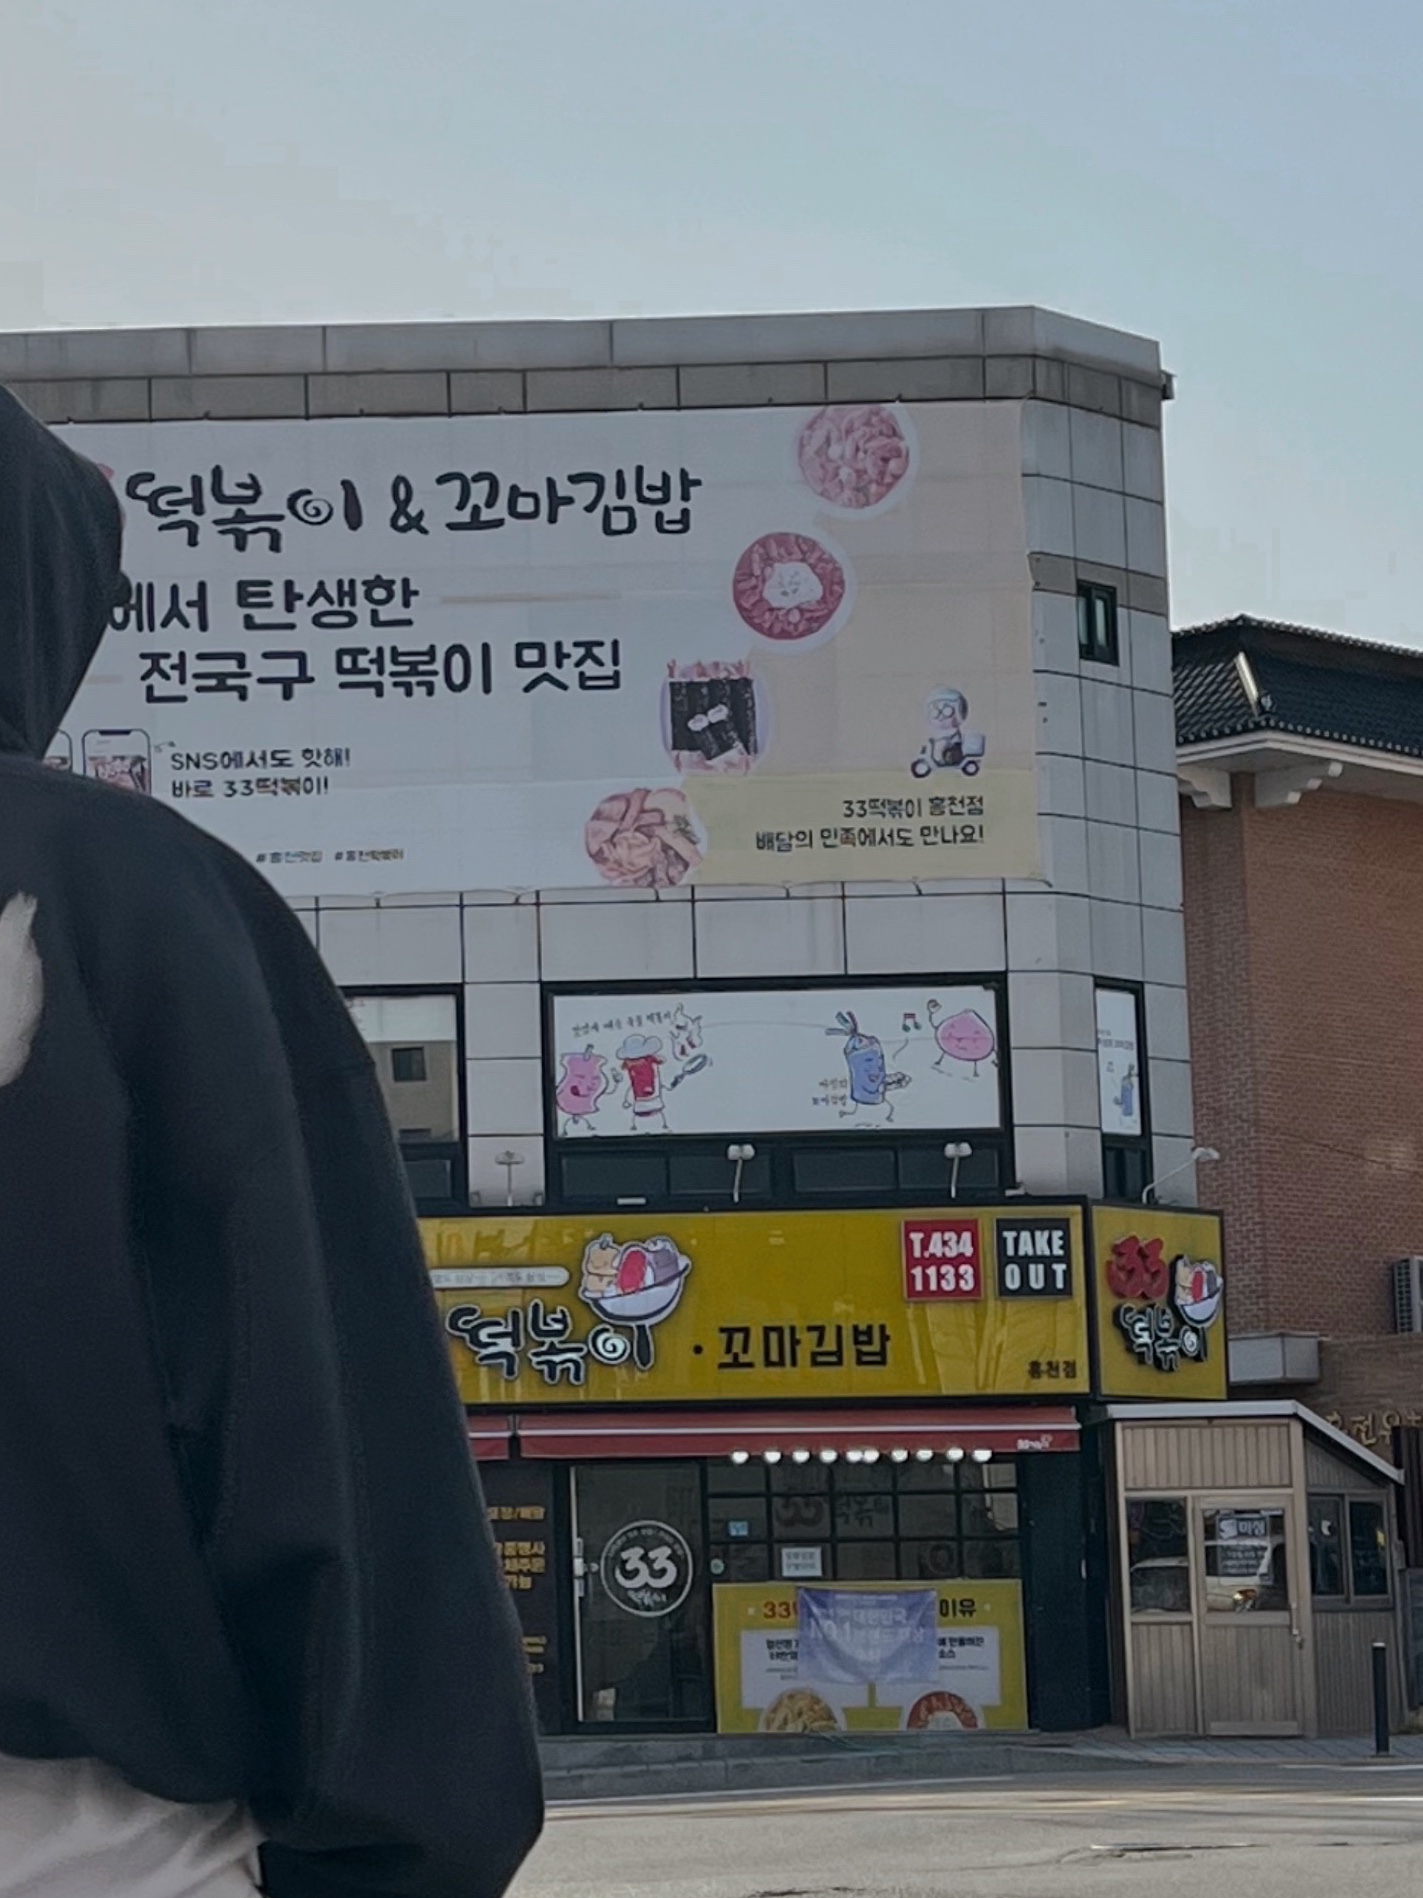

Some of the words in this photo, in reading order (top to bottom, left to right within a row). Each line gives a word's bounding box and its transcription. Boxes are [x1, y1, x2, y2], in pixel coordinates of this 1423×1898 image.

[125, 464, 364, 553] 떡볶이
[389, 474, 429, 535] &
[435, 464, 703, 537] 꼬마김밥
[236, 574, 420, 631] 탄생한
[138, 650, 316, 704] 전국구
[335, 642, 492, 698] 떡볶이
[515, 638, 621, 694] 맛집
[170, 749, 295, 771] SNS에서도
[301, 747, 351, 769] 핫해!
[172, 779, 215, 798] 바로
[223, 776, 329, 798] 33떡볶이!
[842, 797, 923, 819] 33떡볶이
[929, 794, 984, 818] 홍천점
[756, 829, 813, 852] 배달의
[820, 826, 915, 849] 민족에서도
[920, 824, 984, 846] 만나요!
[909, 1231, 974, 1258] T.434
[1002, 1230, 1064, 1257] TAKE
[909, 1263, 975, 1291] 1133
[1004, 1263, 1068, 1291] OUT
[446, 1299, 654, 1384] 떡볶이
[717, 1324, 890, 1370] 꼬마김밥
[1118, 1303, 1207, 1371] 떡볶이
[1028, 1361, 1077, 1379] 홍천점
[615, 1546, 677, 1588] 33
[939, 1598, 977, 1618] 이유
